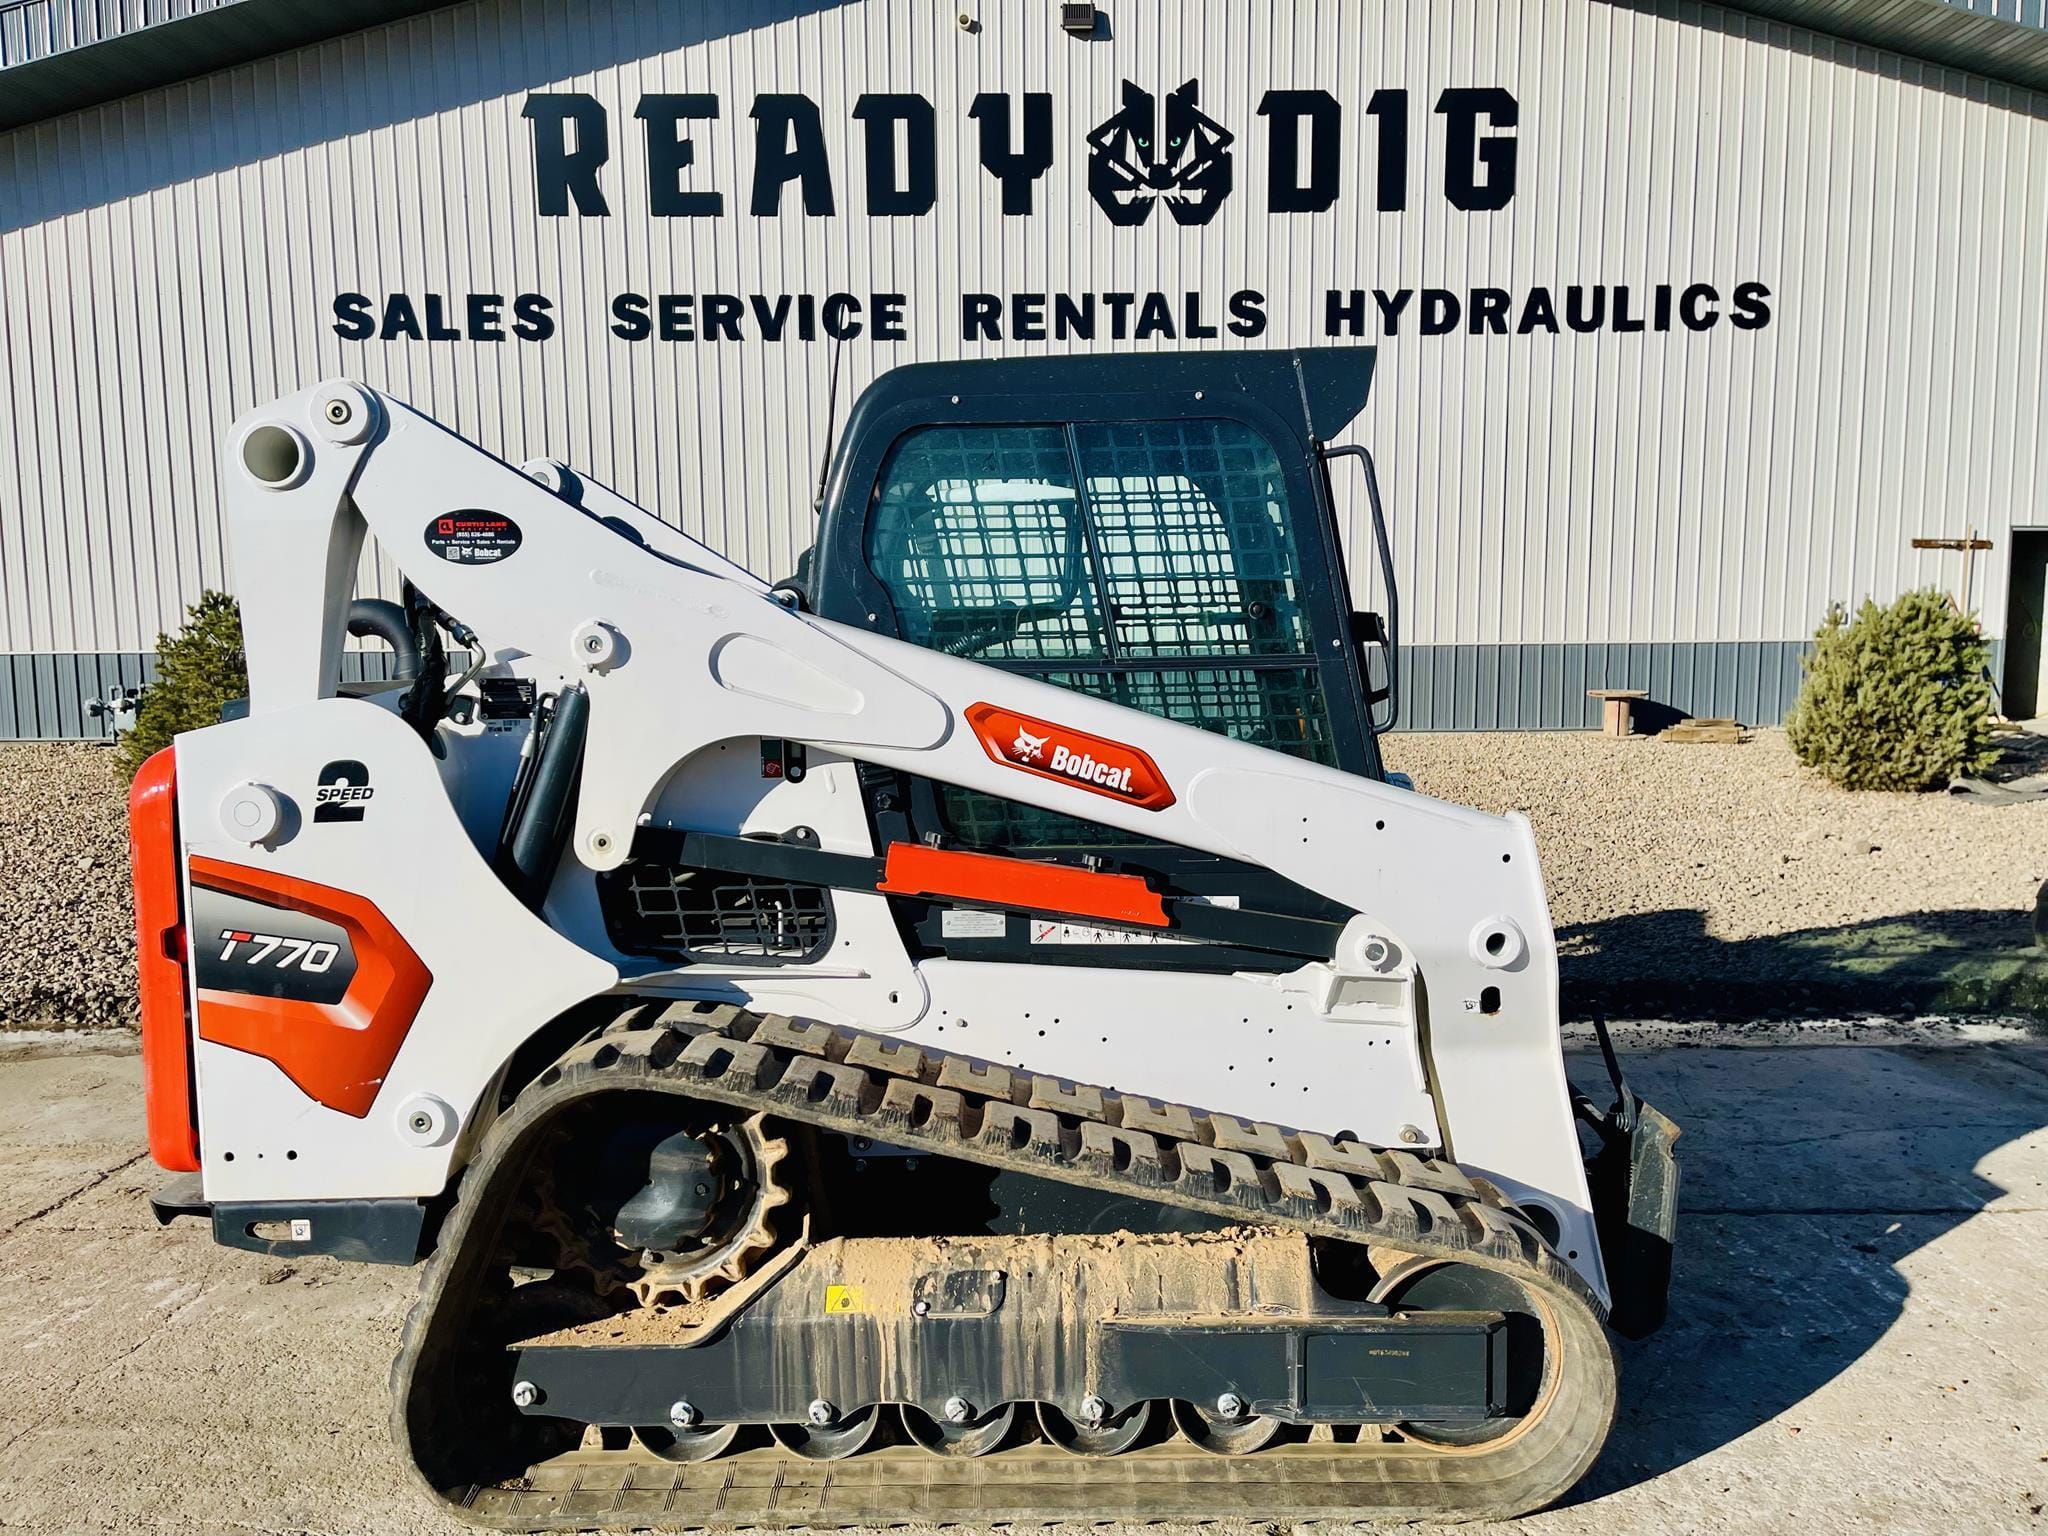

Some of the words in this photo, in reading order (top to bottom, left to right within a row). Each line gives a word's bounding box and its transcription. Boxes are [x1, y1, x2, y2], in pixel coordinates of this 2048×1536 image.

[521, 93, 1053, 217] READY
[1256, 88, 1519, 214] DIG
[332, 292, 555, 342] SALES
[610, 292, 907, 342] SERVICE
[962, 290, 1267, 341] RENTALS
[1325, 282, 1771, 337] HYDRAULICS
[313, 759, 370, 823] 2
[316, 787, 375, 802] SPEED
[219, 929, 341, 974] T770
